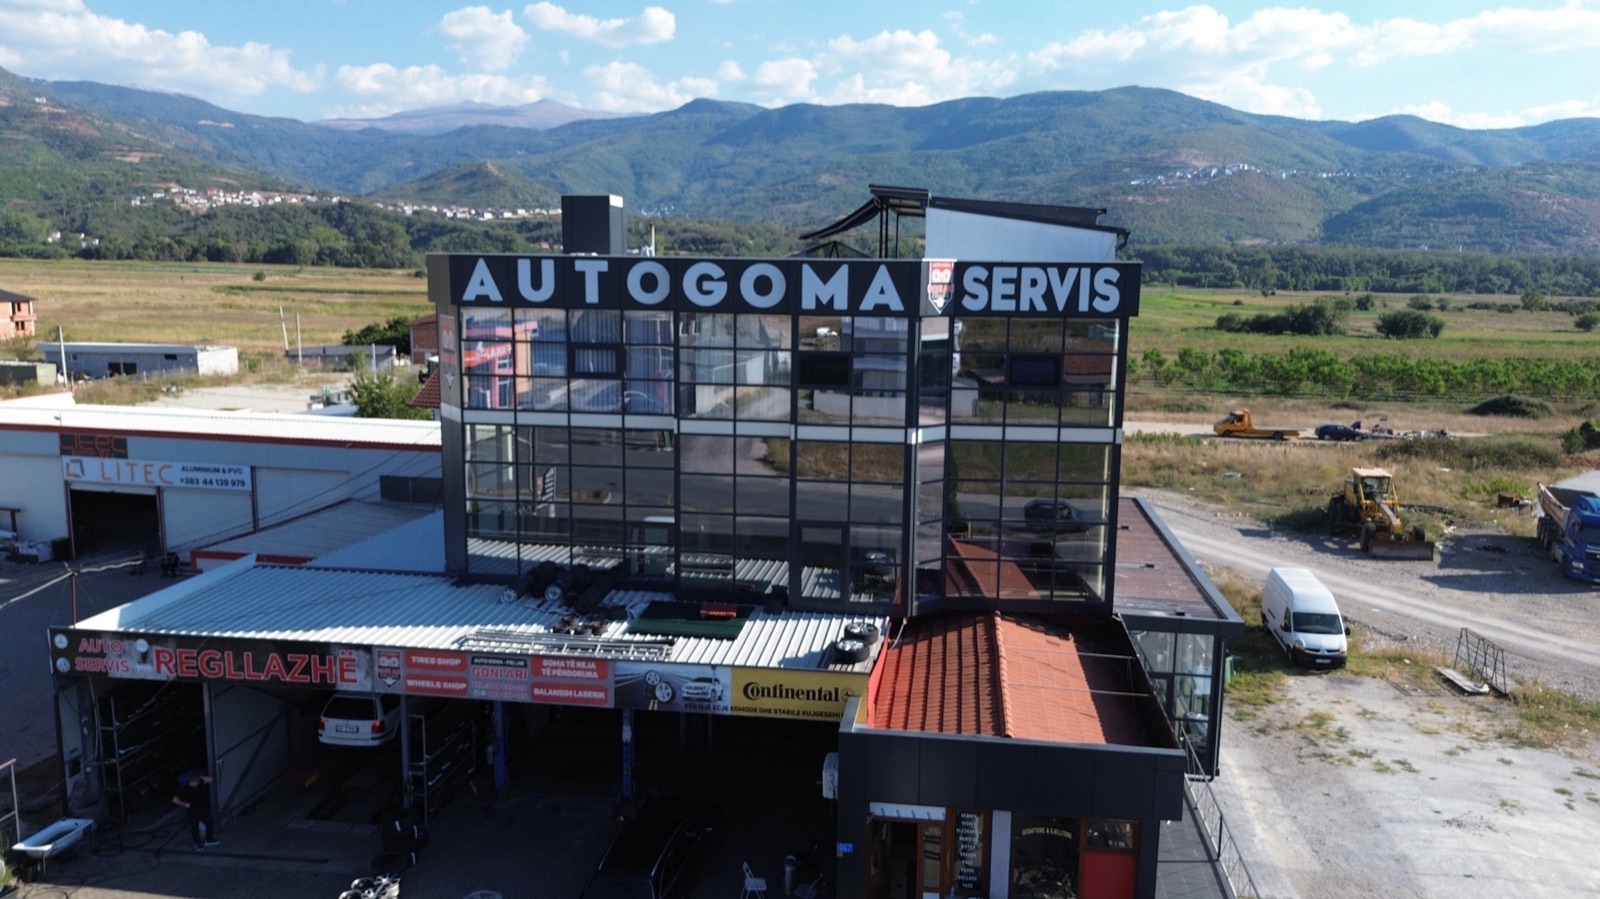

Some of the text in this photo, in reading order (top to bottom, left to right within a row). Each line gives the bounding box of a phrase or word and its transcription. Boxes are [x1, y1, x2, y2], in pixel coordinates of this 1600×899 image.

[462, 257, 1121, 313] AUTOGOMA SERVIS
[100, 461, 174, 485] LITEC
[181, 465, 220, 474] ALUMINIUM
[227, 467, 243, 475] PVC
[180, 476, 200, 485] +383
[202, 478, 213, 486] 44
[79, 637, 125, 654] AUTO
[74, 655, 131, 673] SERVIS
[154, 648, 359, 684] REGLLAZHË
[411, 655, 462, 666] TIRES SHOP
[542, 659, 565, 668] GOMA
[576, 661, 596, 670] REJA
[472, 666, 528, 680] GONI ARI
[406, 678, 442, 689] WHEELS
[442, 681, 467, 690] SHOP
[533, 687, 573, 698] BALANSIM
[573, 689, 606, 699] LASERIK
[743, 681, 839, 702] Continental
[730, 705, 757, 713] KOMODE
[773, 708, 800, 716] STABILE
